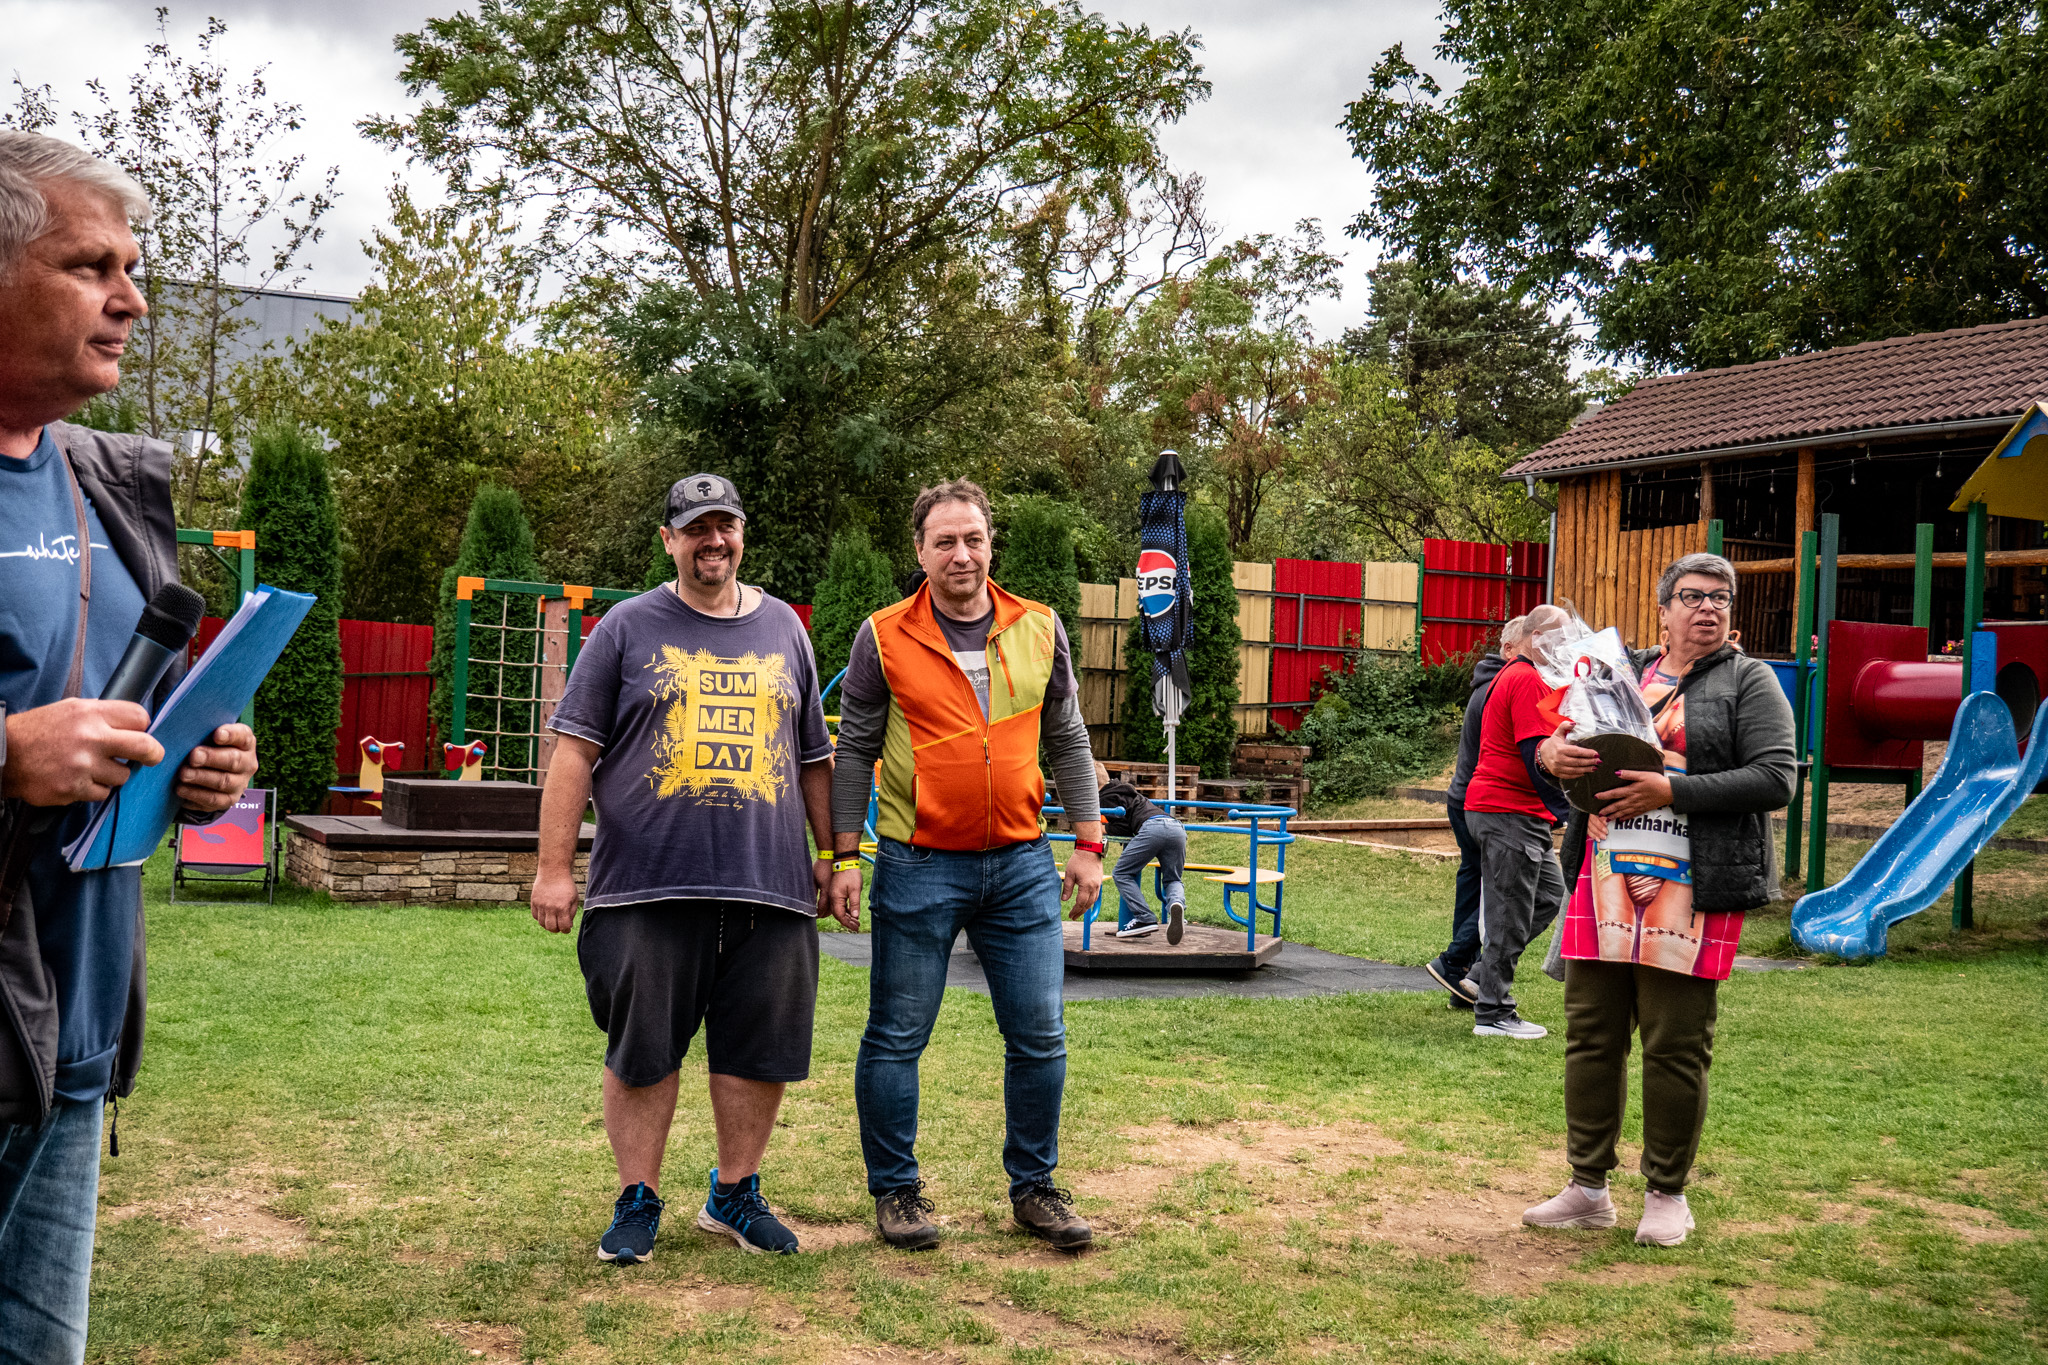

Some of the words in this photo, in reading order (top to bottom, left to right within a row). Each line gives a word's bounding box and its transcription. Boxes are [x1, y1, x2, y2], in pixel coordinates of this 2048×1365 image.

[1136, 576, 1177, 590] EPSI
[700, 673, 756, 694] SUM
[699, 707, 754, 733] MER
[696, 744, 752, 769] DAY
